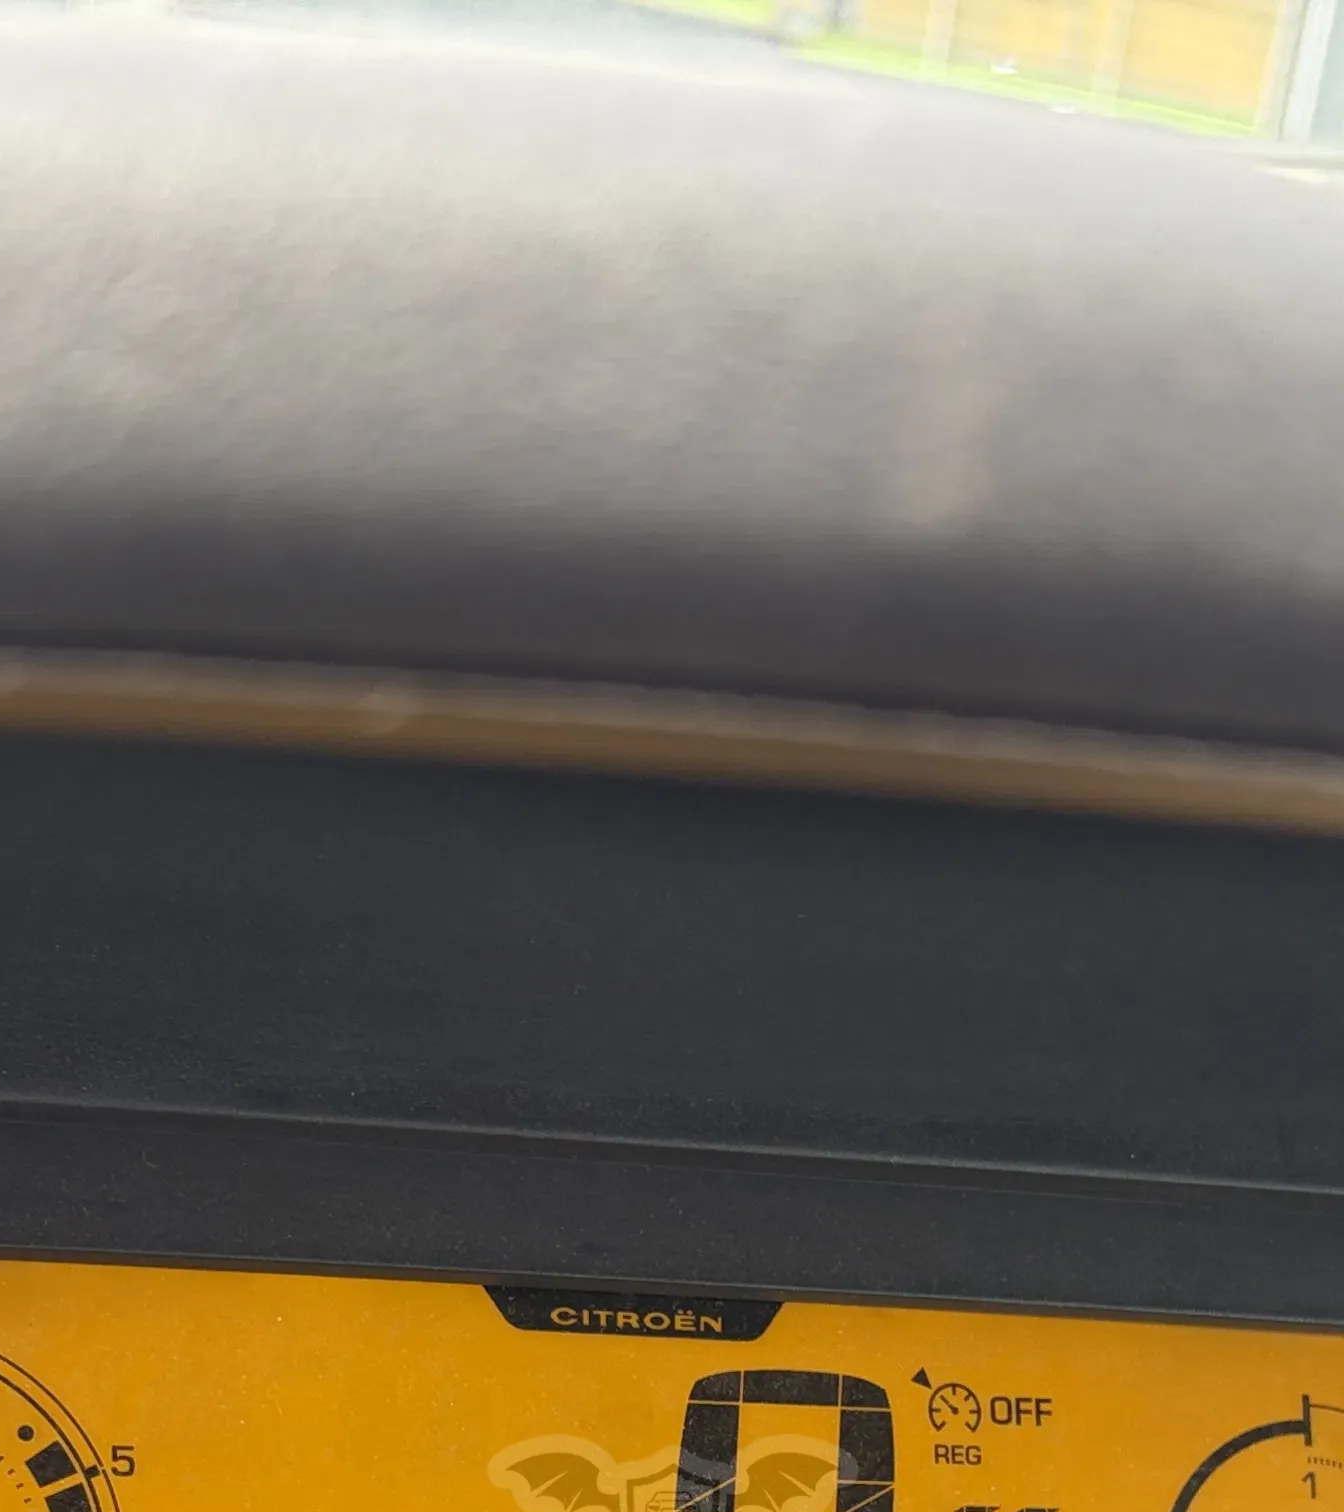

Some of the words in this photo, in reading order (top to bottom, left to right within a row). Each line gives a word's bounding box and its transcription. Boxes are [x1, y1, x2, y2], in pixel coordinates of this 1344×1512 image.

[550, 1306, 723, 1334] CITROËN
[990, 1396, 1053, 1427] OFF
[111, 1446, 135, 1477] 5
[934, 1444, 982, 1466] REG
[1302, 1472, 1317, 1499] 1
